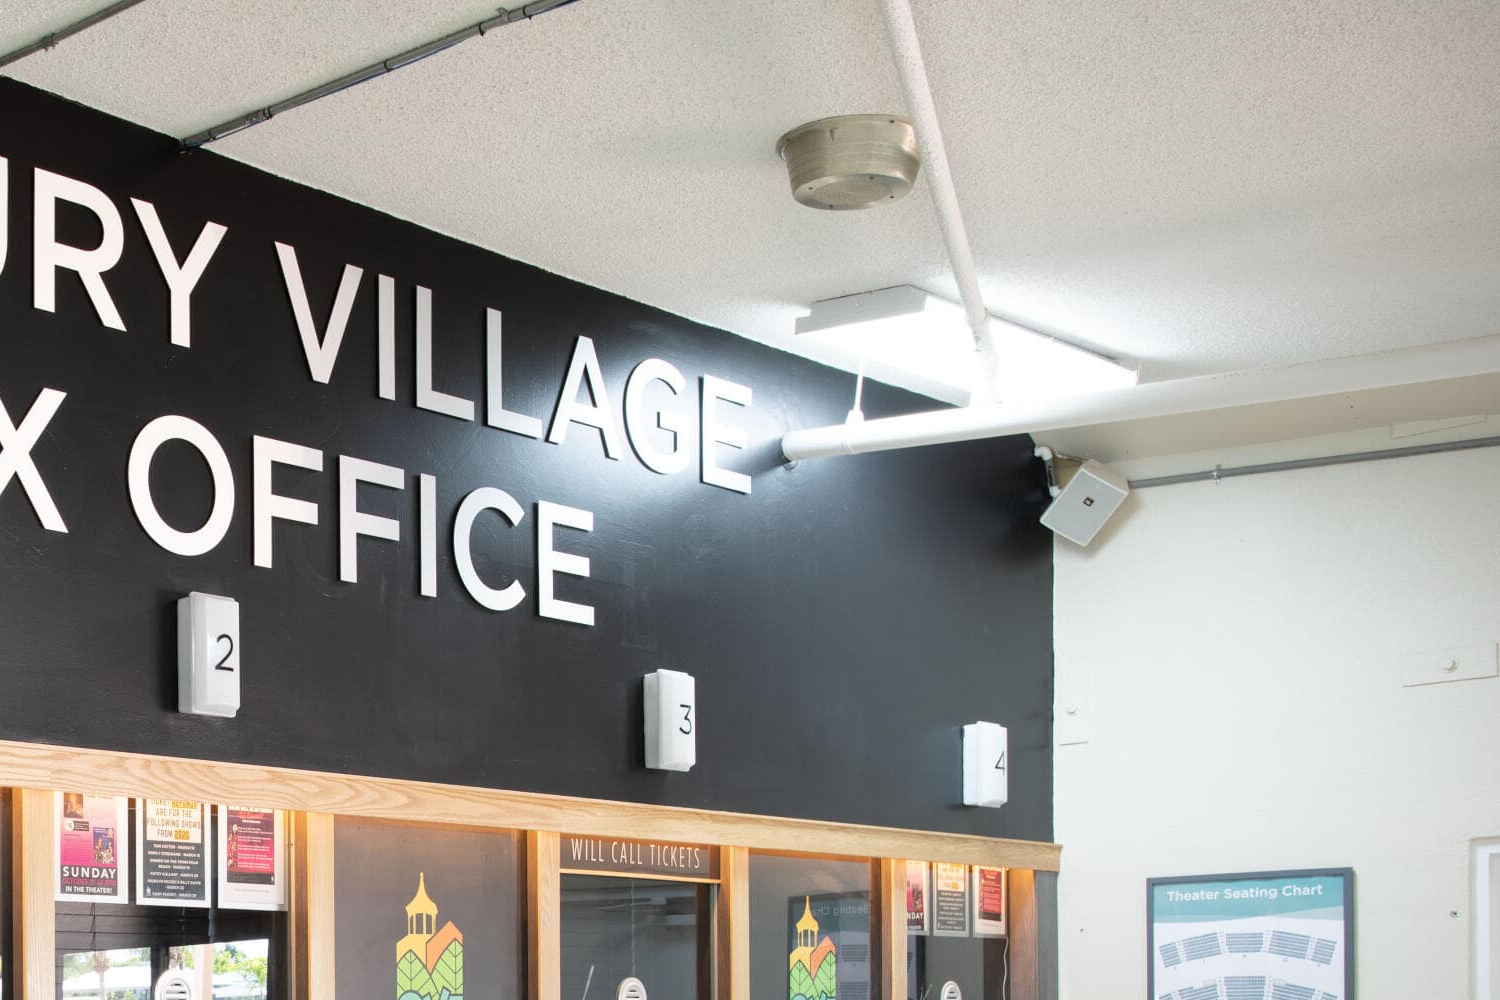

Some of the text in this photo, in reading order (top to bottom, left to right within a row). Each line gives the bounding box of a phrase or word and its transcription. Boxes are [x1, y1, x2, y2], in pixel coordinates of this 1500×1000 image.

[275, 241, 752, 494] VILLAGE
[128, 414, 595, 626] OFFICE
[215, 634, 234, 672] 2
[680, 704, 691, 735] 3
[995, 750, 1005, 776] 4
[572, 838, 700, 869] WILL CALL TICKETS
[63, 866, 116, 879] SUNDAY
[1167, 884, 1323, 901] Theater Seating Chart
[907, 912, 924, 920] NDAY
